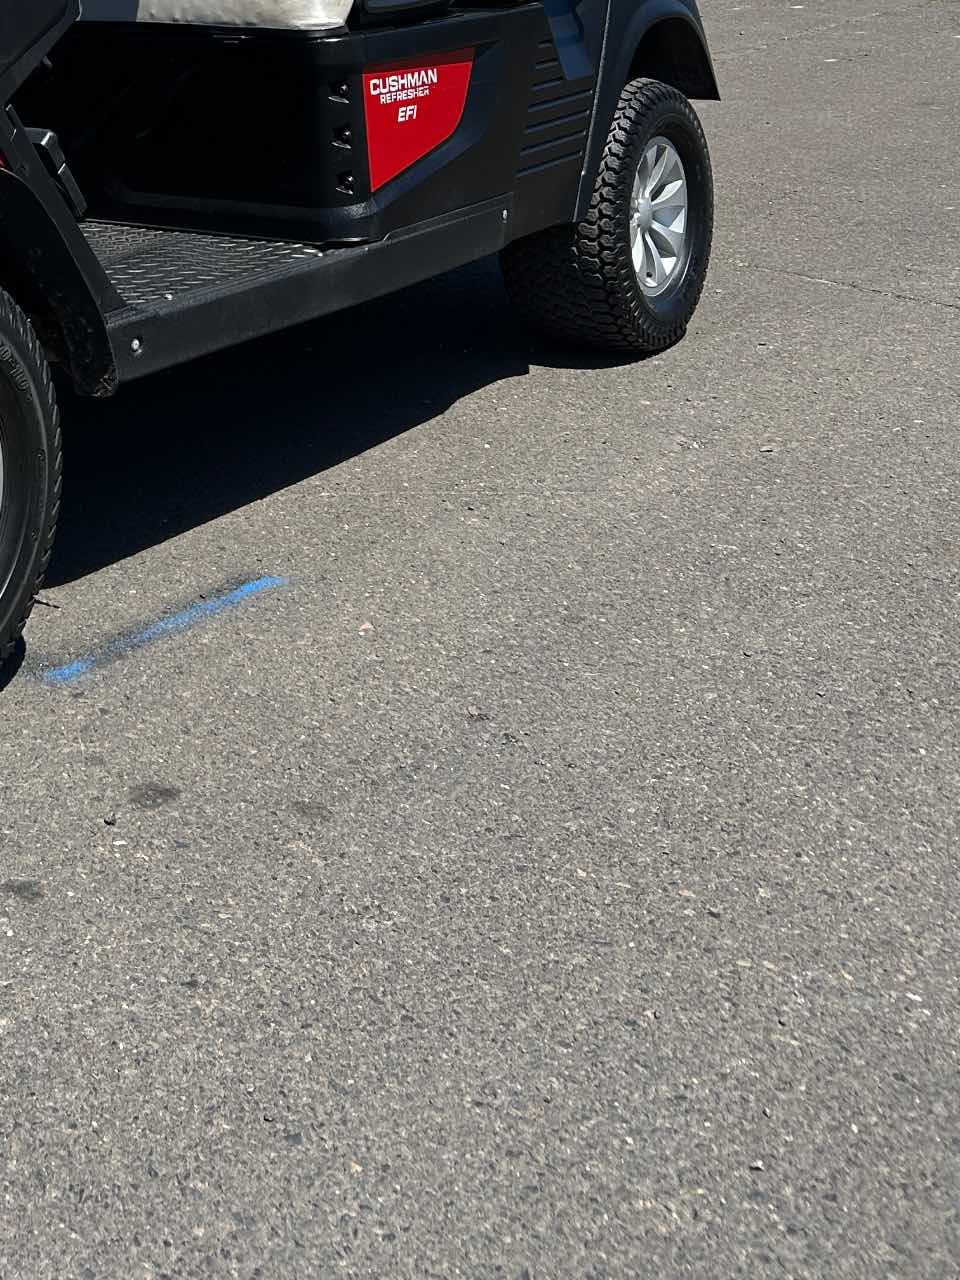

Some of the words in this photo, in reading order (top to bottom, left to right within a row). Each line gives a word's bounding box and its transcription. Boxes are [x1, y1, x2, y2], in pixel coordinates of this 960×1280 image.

[369, 68, 438, 96] CUSHMAN
[380, 86, 429, 104] REFRESHER
[397, 104, 418, 122] EFI
